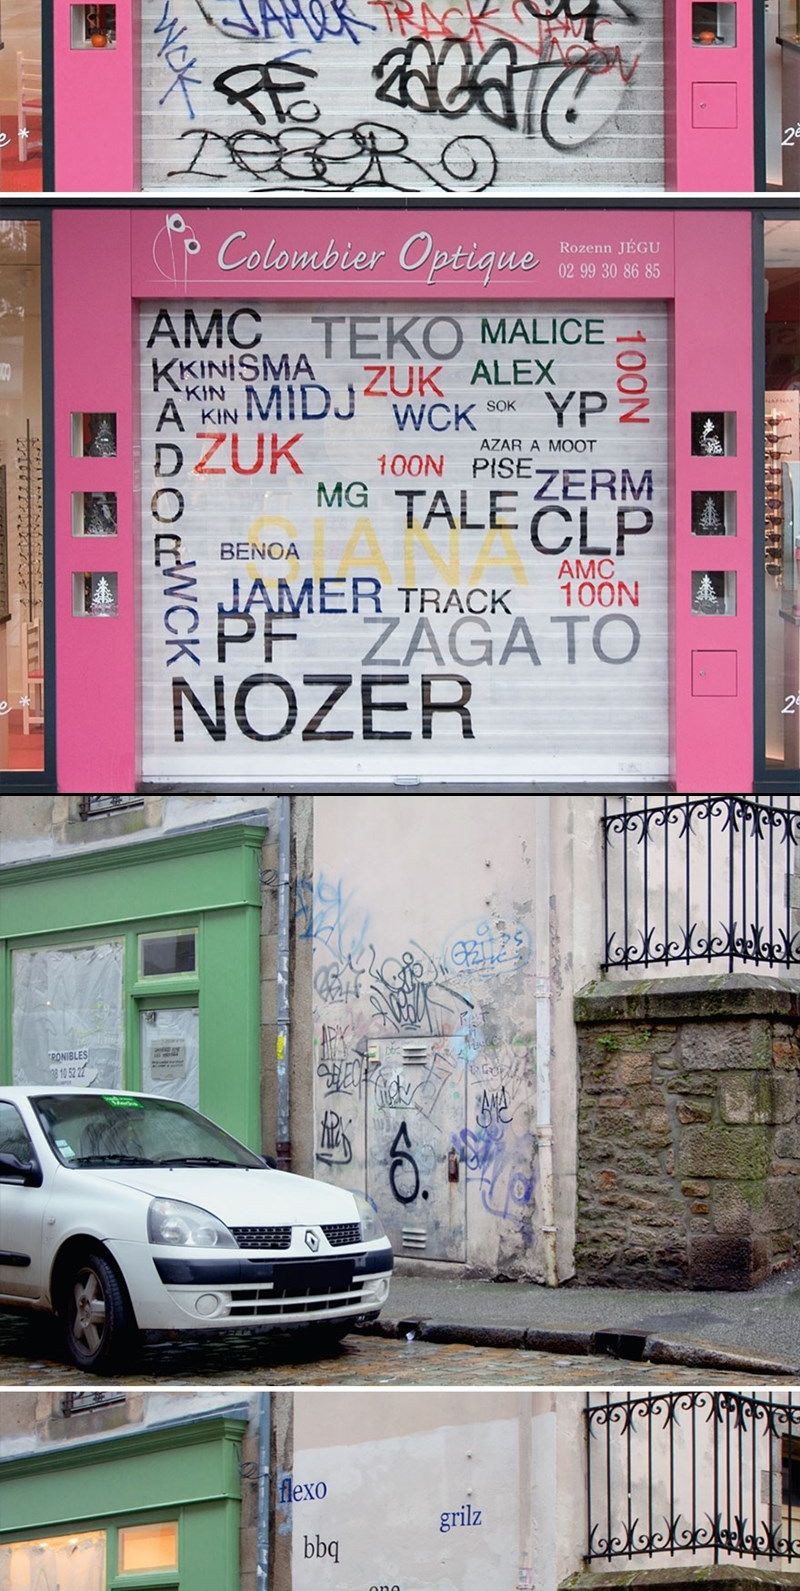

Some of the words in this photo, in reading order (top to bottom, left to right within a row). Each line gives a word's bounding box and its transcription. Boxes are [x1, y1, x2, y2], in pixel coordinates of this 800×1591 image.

[217, 231, 386, 272] Colombier
[399, 231, 540, 288] Optique
[559, 241, 612, 254] Rozenn
[618, 238, 661, 254] JÉGU
[558, 263, 574, 279] 02
[580, 263, 596, 279] 99
[602, 263, 618, 279] 30
[623, 263, 639, 279] 86
[645, 263, 661, 279] 85
[146, 308, 262, 349] AMC
[311, 315, 464, 360] TEKO
[480, 318, 605, 345] MALICE
[363, 365, 444, 397] ZUK
[470, 359, 555, 385] ALEX
[615, 330, 651, 424] 100N
[186, 385, 226, 402] KIN
[245, 384, 356, 421] MIDJ
[486, 400, 516, 412] SOK
[201, 408, 238, 425] KIN
[392, 403, 477, 432] WCK
[545, 391, 608, 428] YP
[194, 432, 304, 475] ZUK
[480, 438, 521, 452] AZAR
[530, 439, 540, 452] A
[549, 439, 596, 453] MOOT
[377, 454, 444, 477] 100N
[472, 458, 533, 479] PISE
[316, 481, 369, 508] MG
[534, 469, 653, 501] ZERM
[395, 489, 518, 530] TALE
[530, 505, 654, 556] CLP
[220, 542, 300, 560] BENOA
[245, 516, 528, 589] SIANA
[558, 559, 615, 580] AMC
[217, 577, 382, 614] JAMER
[398, 588, 512, 615] TRACK
[561, 581, 639, 607] 100N
[162, 560, 200, 667] WCK
[217, 611, 301, 663] PF
[172, 672, 476, 743] NOZER
[279, 1478, 327, 1503] flexo
[439, 1505, 482, 1533] grilz
[303, 1535, 340, 1563] bbq
